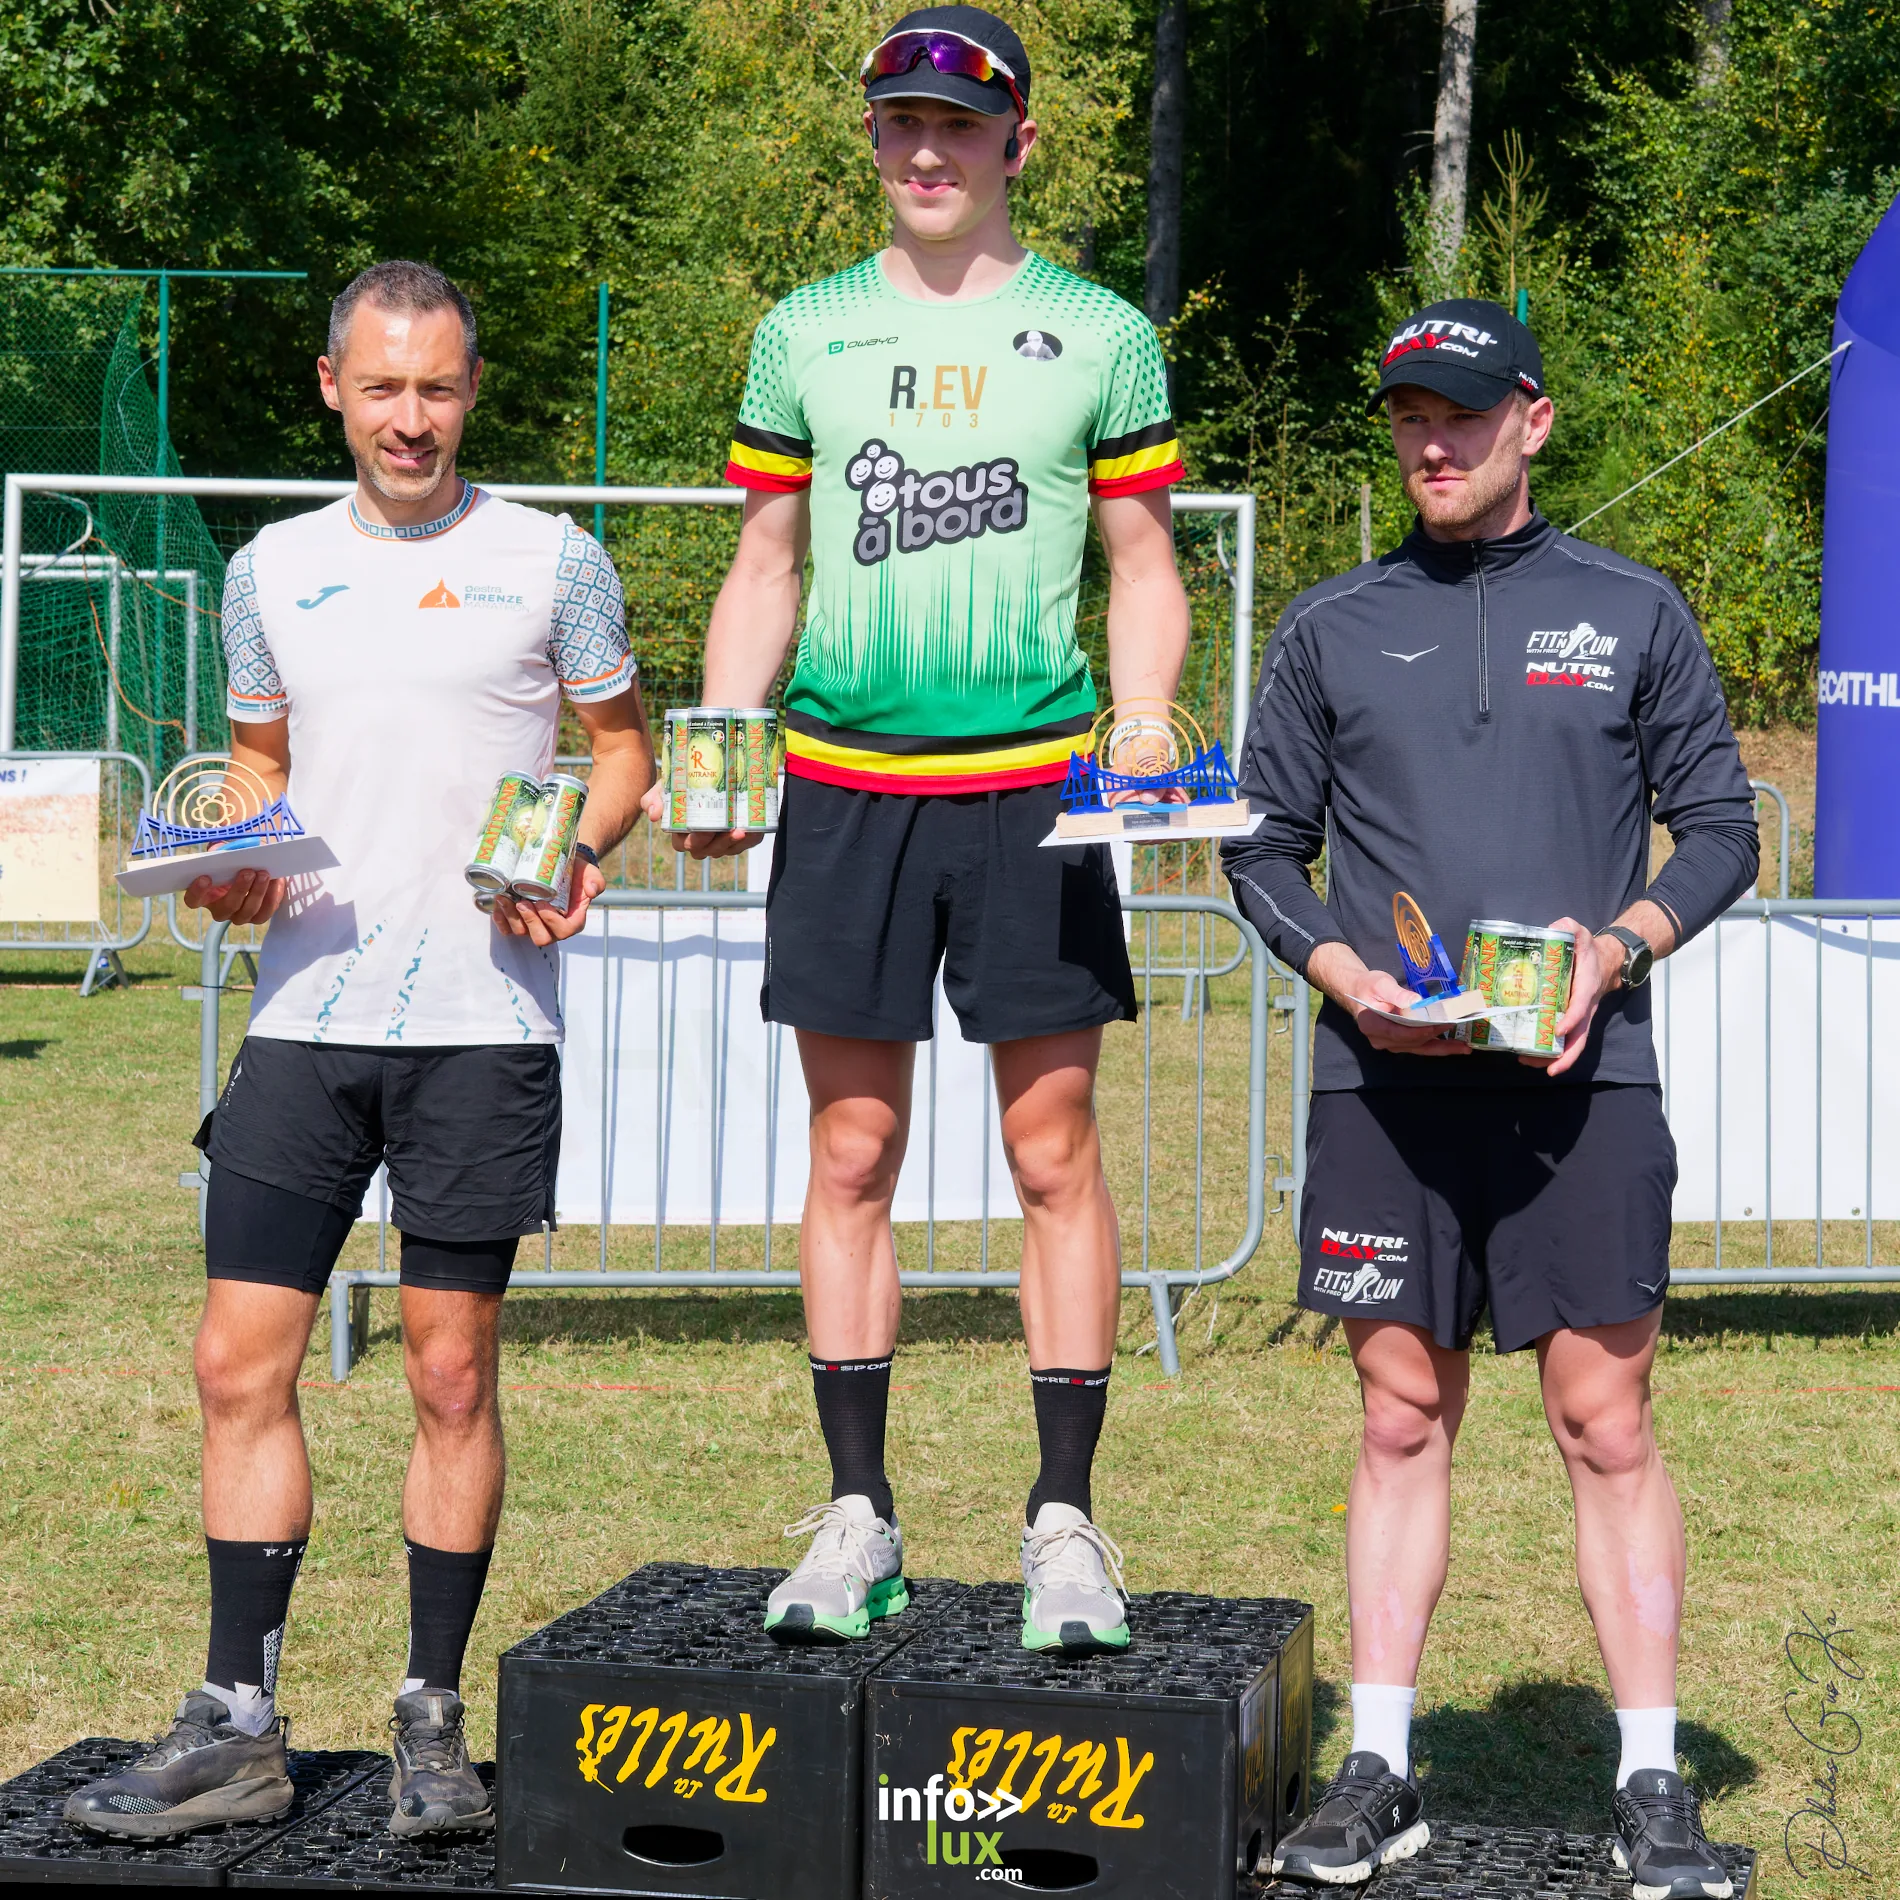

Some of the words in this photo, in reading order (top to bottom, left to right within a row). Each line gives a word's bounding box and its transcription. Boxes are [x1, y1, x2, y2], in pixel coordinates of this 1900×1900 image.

[1388, 320, 1498, 354] NUTRI-
[889, 365, 988, 410] R.EV
[899, 463, 1013, 509] tous
[858, 517, 886, 561] à
[902, 487, 1023, 548] bord
[463, 601, 530, 613] MARATHON
[464, 593, 523, 605] FIRENZE
[1526, 662, 1615, 678] NUTRI-
[748, 722, 766, 823] MAITRANK
[1537, 943, 1562, 1047] MAITRANK
[1321, 1227, 1409, 1249] NUTRI-
[1313, 1285, 1326, 1293] WITH
[1326, 1288, 1342, 1297] FRED
[576, 1703, 777, 1803] Rulles
[947, 1727, 1155, 1829] Rulles
